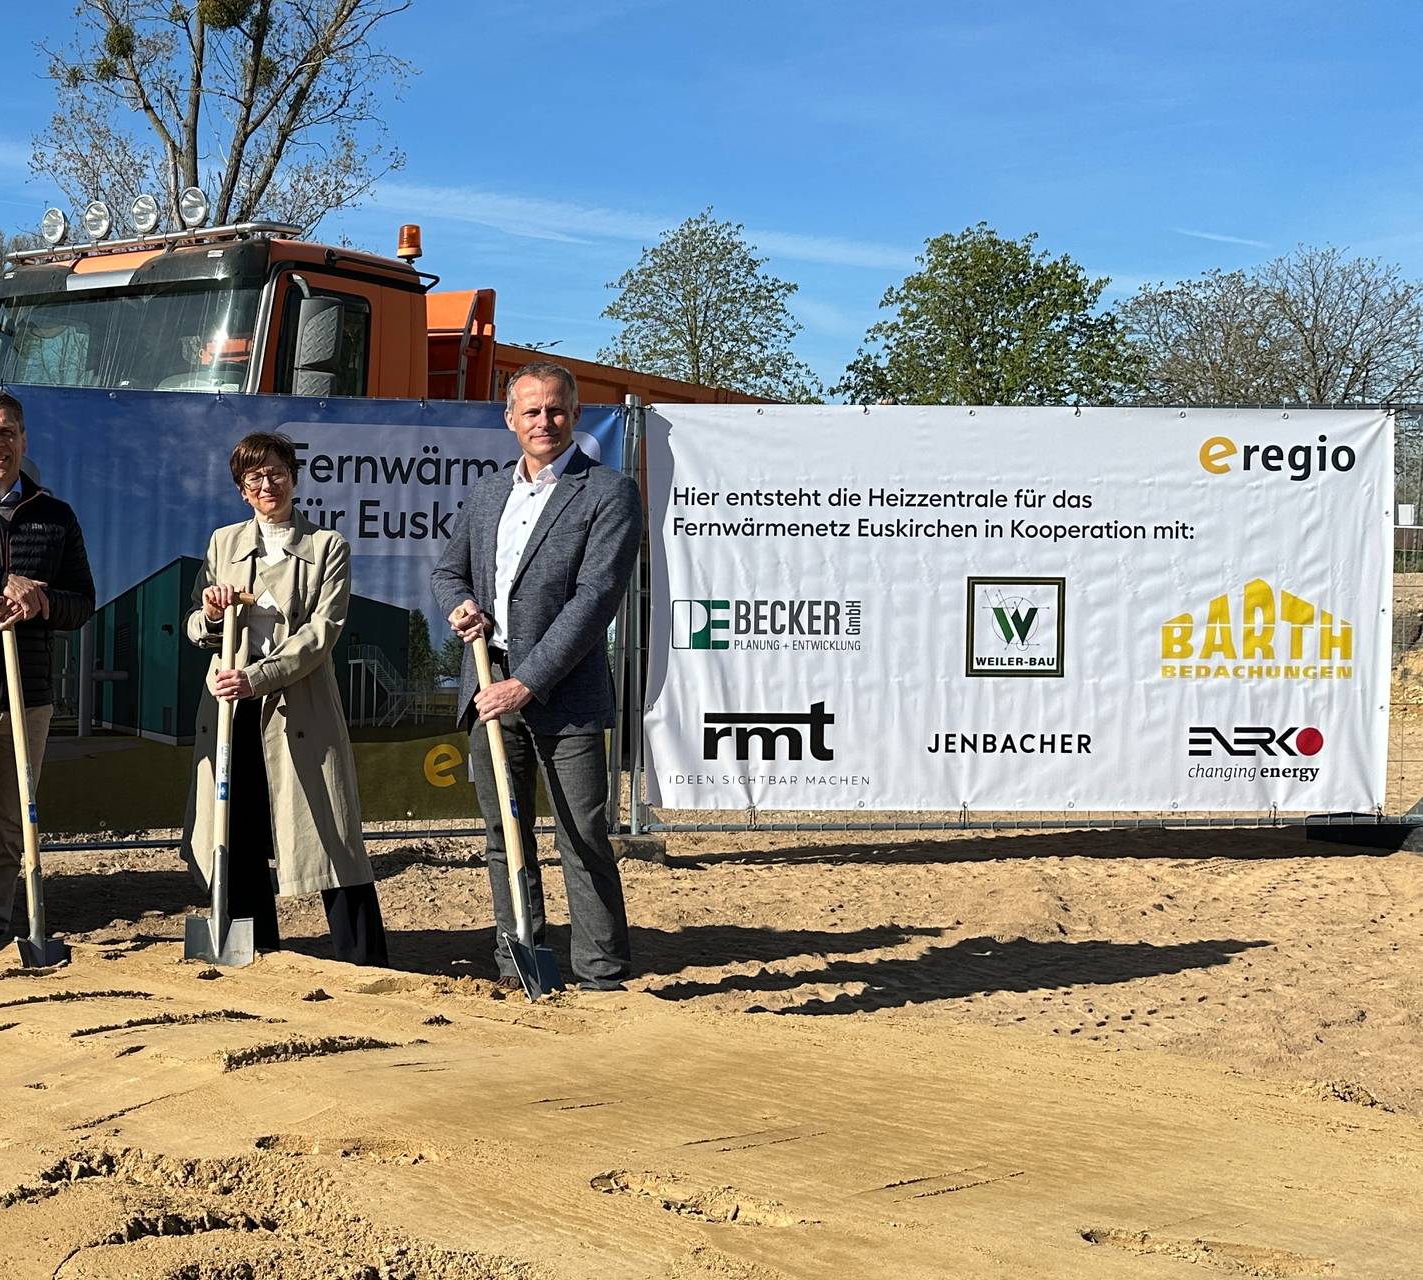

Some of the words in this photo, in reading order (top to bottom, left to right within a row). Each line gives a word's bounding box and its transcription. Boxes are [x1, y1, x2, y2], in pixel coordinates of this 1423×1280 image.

[291, 443, 519, 486] ernwärm
[673, 487, 719, 506] Hier
[727, 488, 821, 507] entsteht
[828, 488, 861, 507] die
[868, 488, 1008, 509] Heizzentrale
[1014, 489, 1046, 509] für
[1052, 490, 1093, 509] das
[291, 497, 346, 531] ür
[358, 499, 463, 540] Eusk
[673, 517, 850, 537] Fernwärmenetz
[857, 518, 977, 538] Euskirchen
[984, 519, 1004, 538] in
[1010, 519, 1146, 542] Kooperation
[1153, 521, 1195, 540] mit:
[734, 599, 841, 635] BECKER
[845, 600, 862, 636] GmbH
[1161, 578, 1353, 660] BARTH
[734, 639, 780, 651] PLANUNG
[792, 639, 862, 651] ENTWICKLUNG
[975, 656, 1055, 667] WEILER-BAU
[1161, 665, 1353, 680] BEDACHUNGEN
[703, 701, 835, 761] rmt
[927, 733, 1092, 754] JENBACHER
[669, 774, 715, 785] IDEEN
[722, 774, 798, 785] SICHTBAR
[805, 775, 870, 786] MACHEN
[1188, 763, 1257, 782] changing
[1260, 765, 1320, 782] energy
